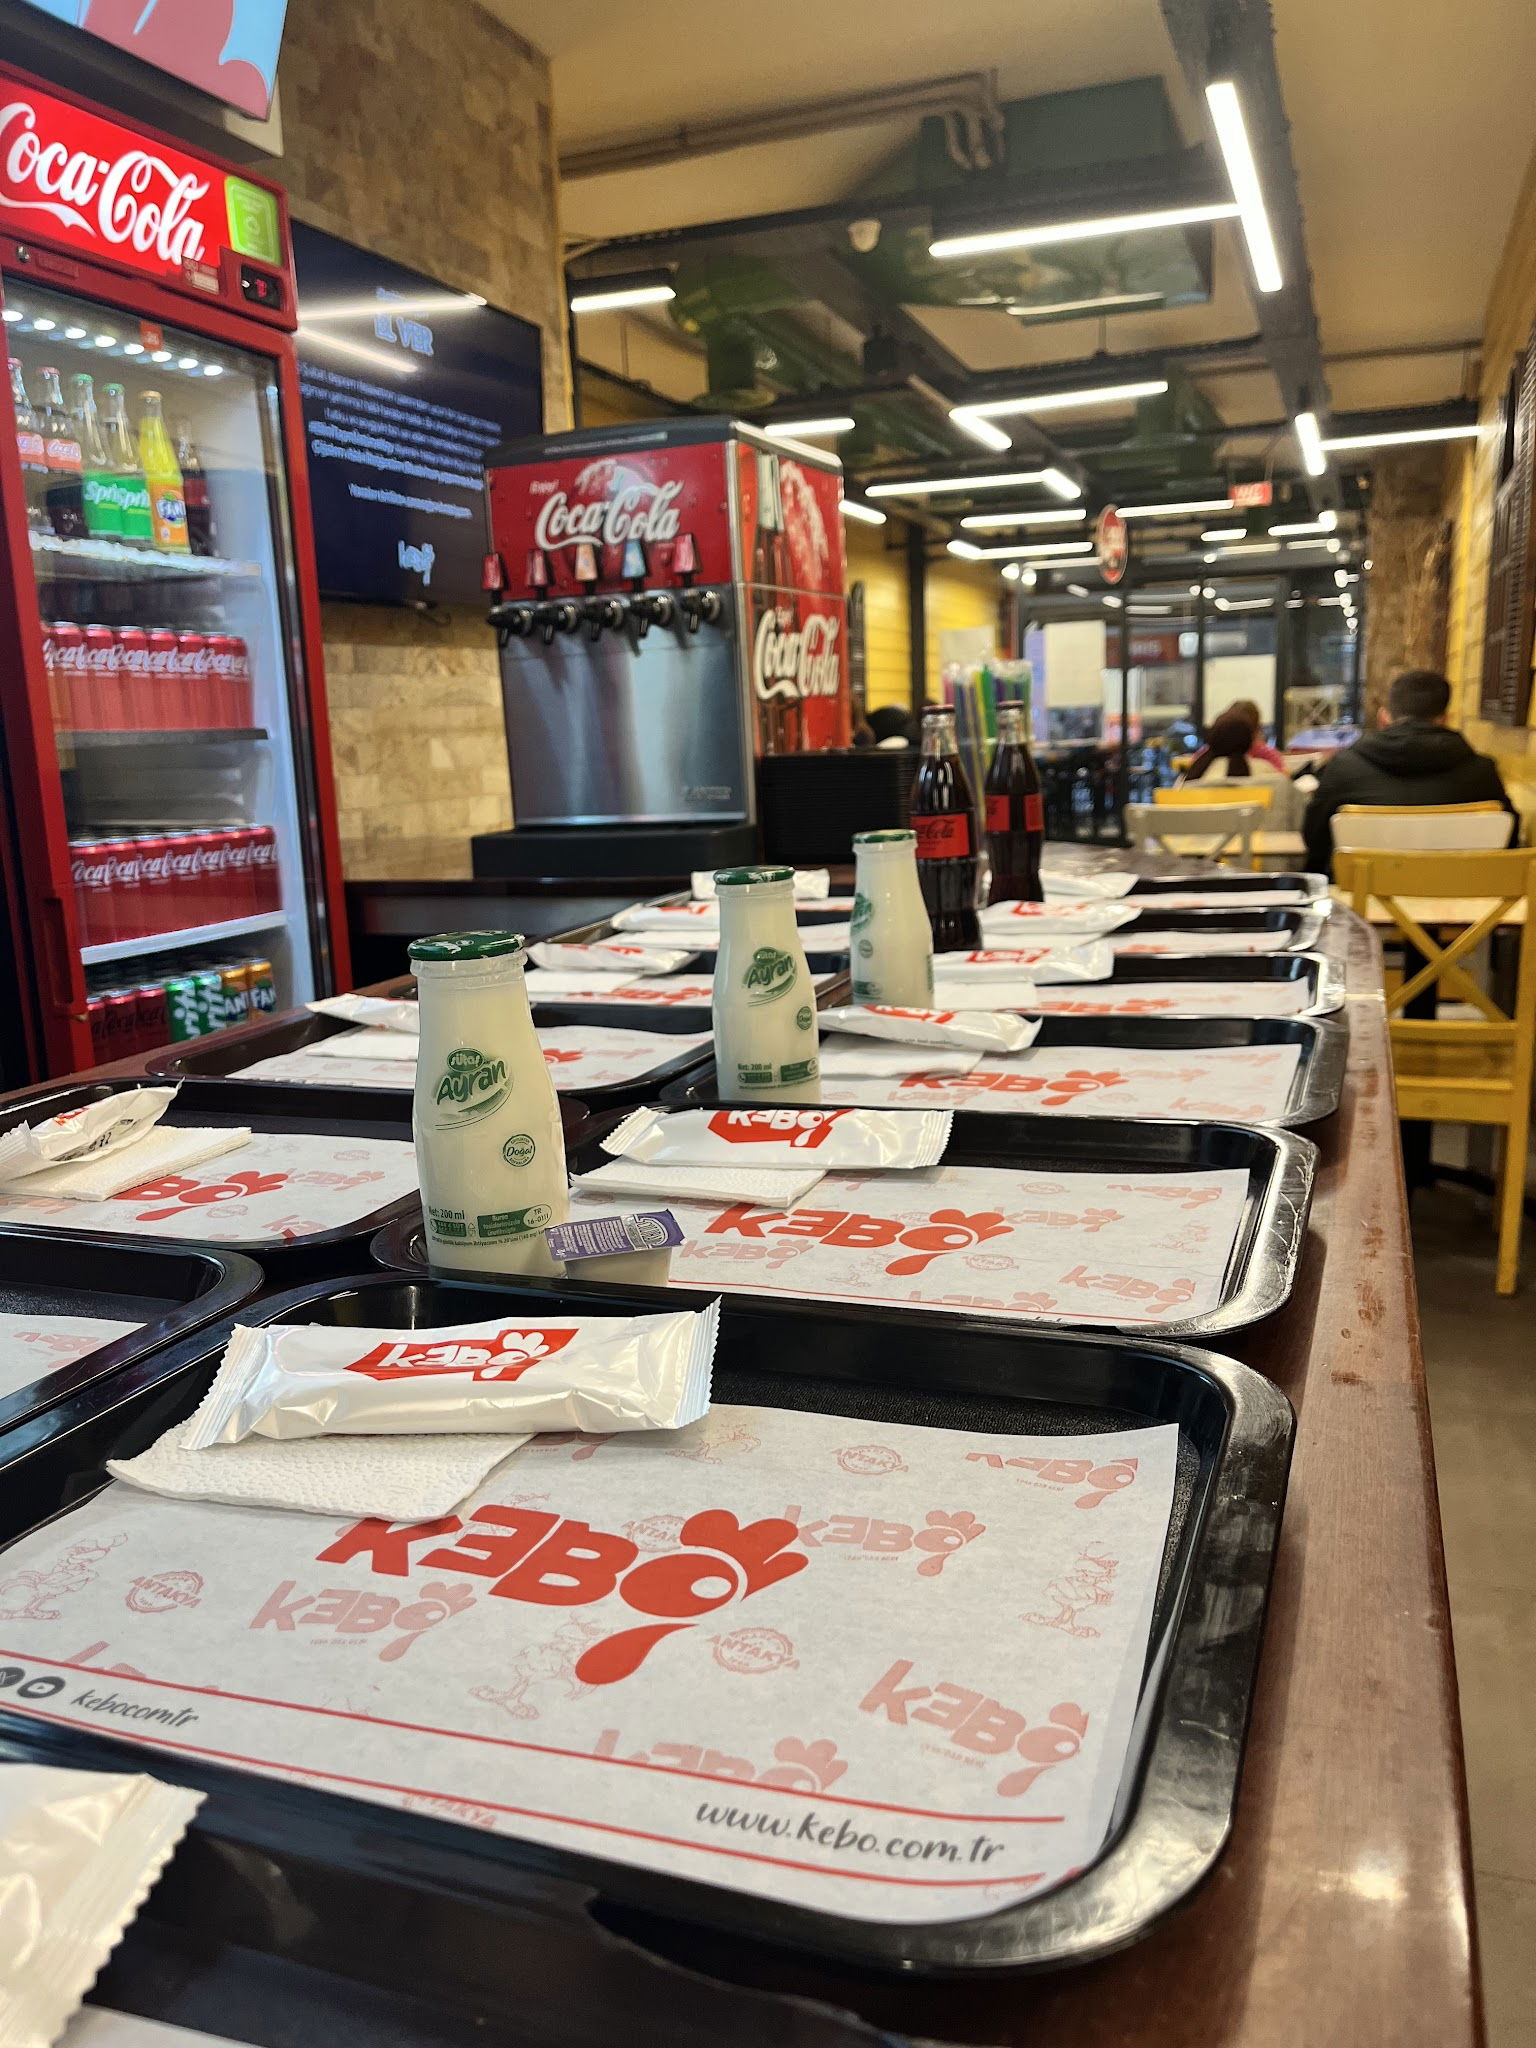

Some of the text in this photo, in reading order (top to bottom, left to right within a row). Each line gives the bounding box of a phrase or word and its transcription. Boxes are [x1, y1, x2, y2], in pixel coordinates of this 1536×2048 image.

[535, 479, 685, 551] Coca-Cola
[753, 608, 841, 701] Coca-Cola
[747, 955, 793, 988] Ayran
[436, 1059, 507, 1106] Ayran
[440, 1208, 453, 1220] 200
[454, 1210, 465, 1220] ml
[71, 1689, 201, 1728] kebocomtr
[696, 1797, 1005, 1864] www.kebo.com.tr
